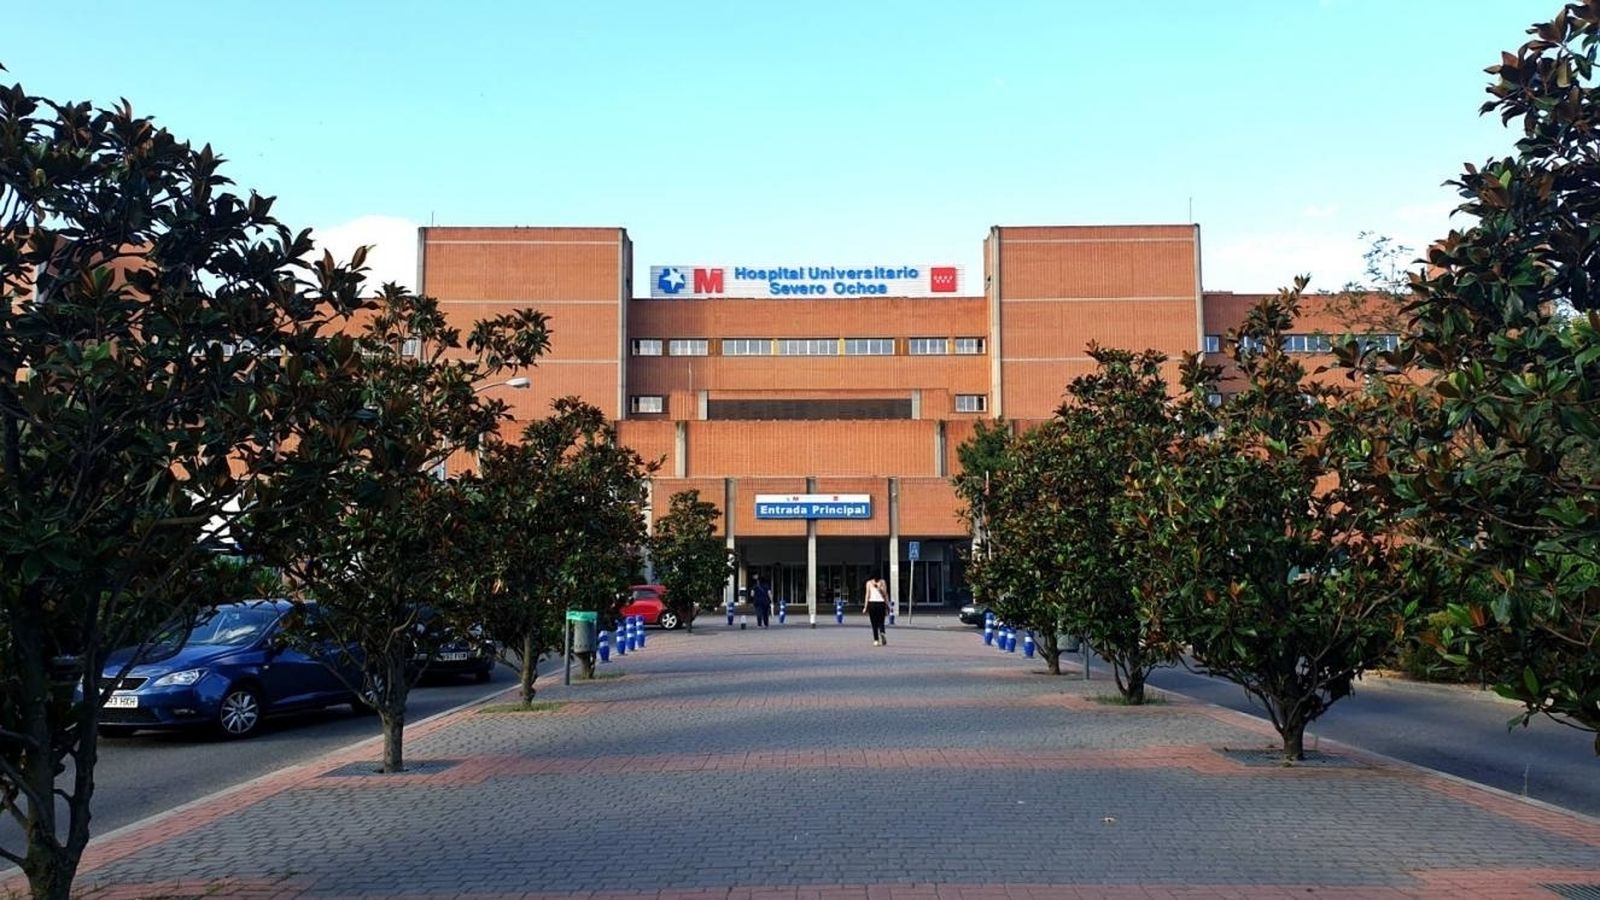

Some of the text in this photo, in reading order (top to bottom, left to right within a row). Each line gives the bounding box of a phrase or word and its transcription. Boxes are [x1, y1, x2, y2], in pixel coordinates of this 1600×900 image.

[694, 269, 724, 293] M
[735, 266, 919, 282] Hospital Universitario
[769, 282, 888, 295] Severo Ochoa
[760, 505, 866, 517] Entrada Principal
